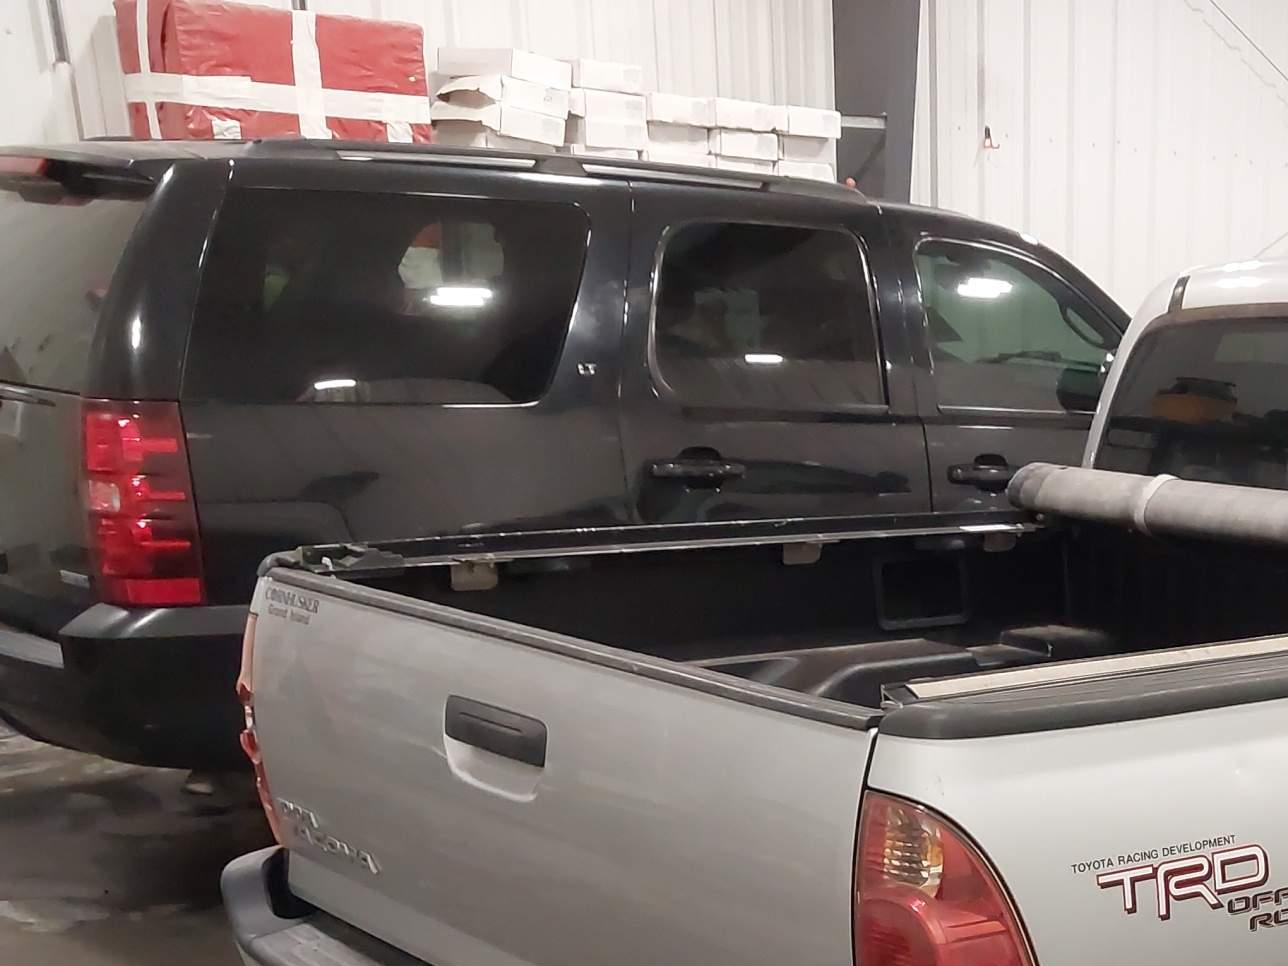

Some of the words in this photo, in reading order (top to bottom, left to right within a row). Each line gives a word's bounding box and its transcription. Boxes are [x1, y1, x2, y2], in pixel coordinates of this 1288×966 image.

[1071, 857, 1114, 875] TOYOTA
[1118, 849, 1159, 867] RACING
[1162, 834, 1237, 858] DEVELOPMENT
[1096, 843, 1270, 921] TRD
